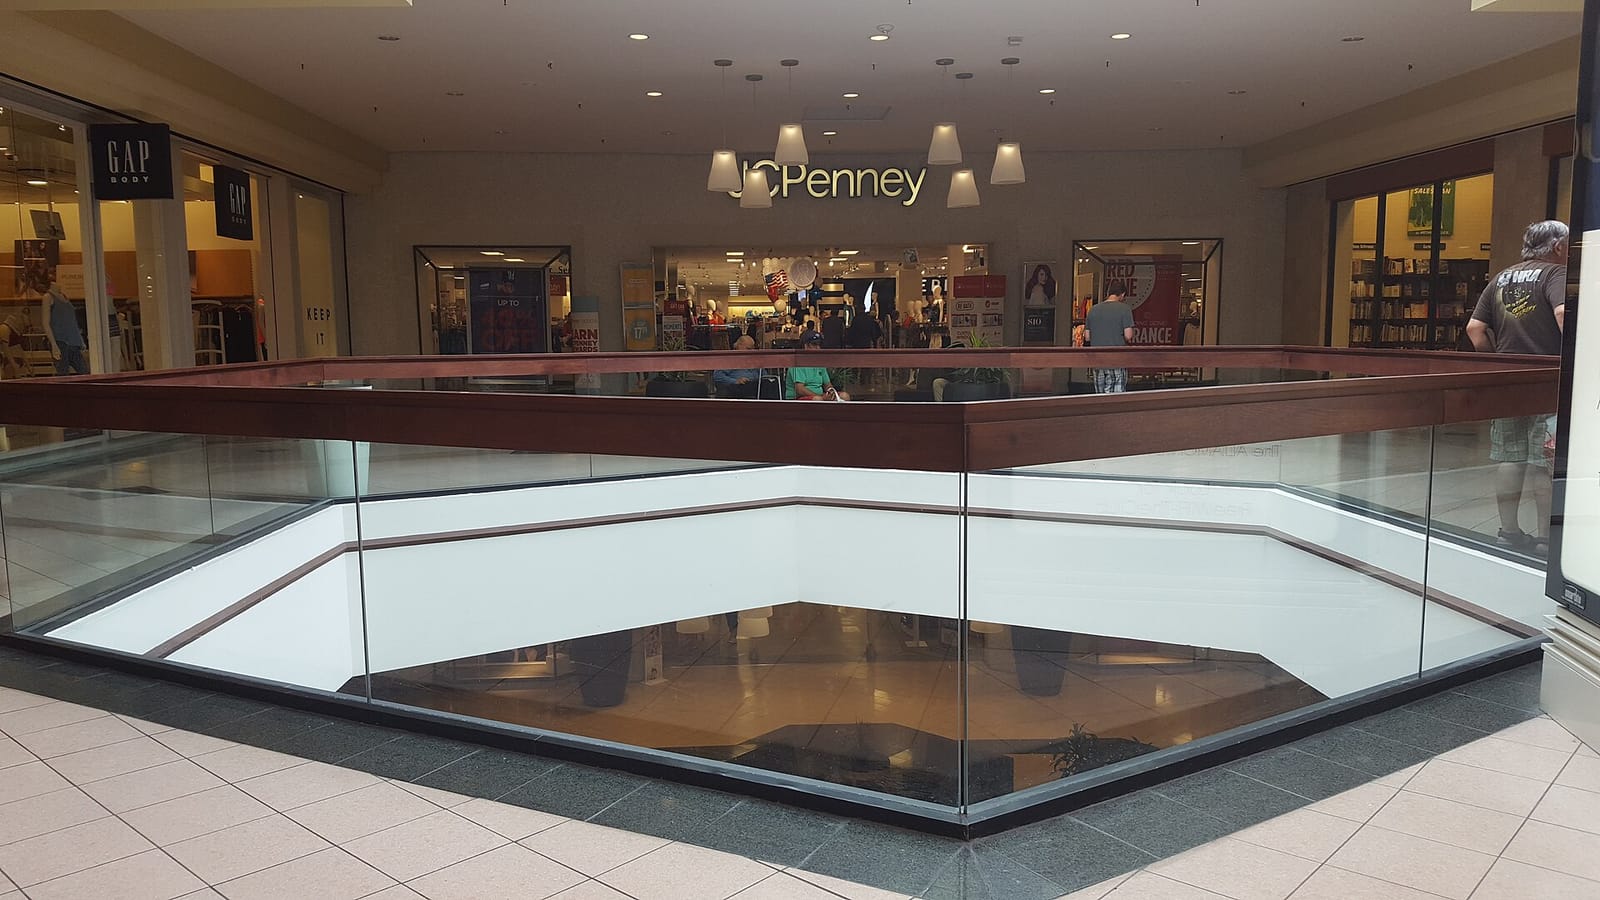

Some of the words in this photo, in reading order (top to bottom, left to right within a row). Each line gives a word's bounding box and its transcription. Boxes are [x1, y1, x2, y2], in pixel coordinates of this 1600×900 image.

[107, 140, 150, 173] GAP
[727, 159, 927, 207] JCPenney
[229, 183, 247, 216] GAP
[1106, 259, 1135, 277] RED
[1106, 278, 1138, 297] ZNE
[307, 307, 331, 321] KEEP
[316, 333, 324, 345] IT
[573, 329, 598, 339] ARN
